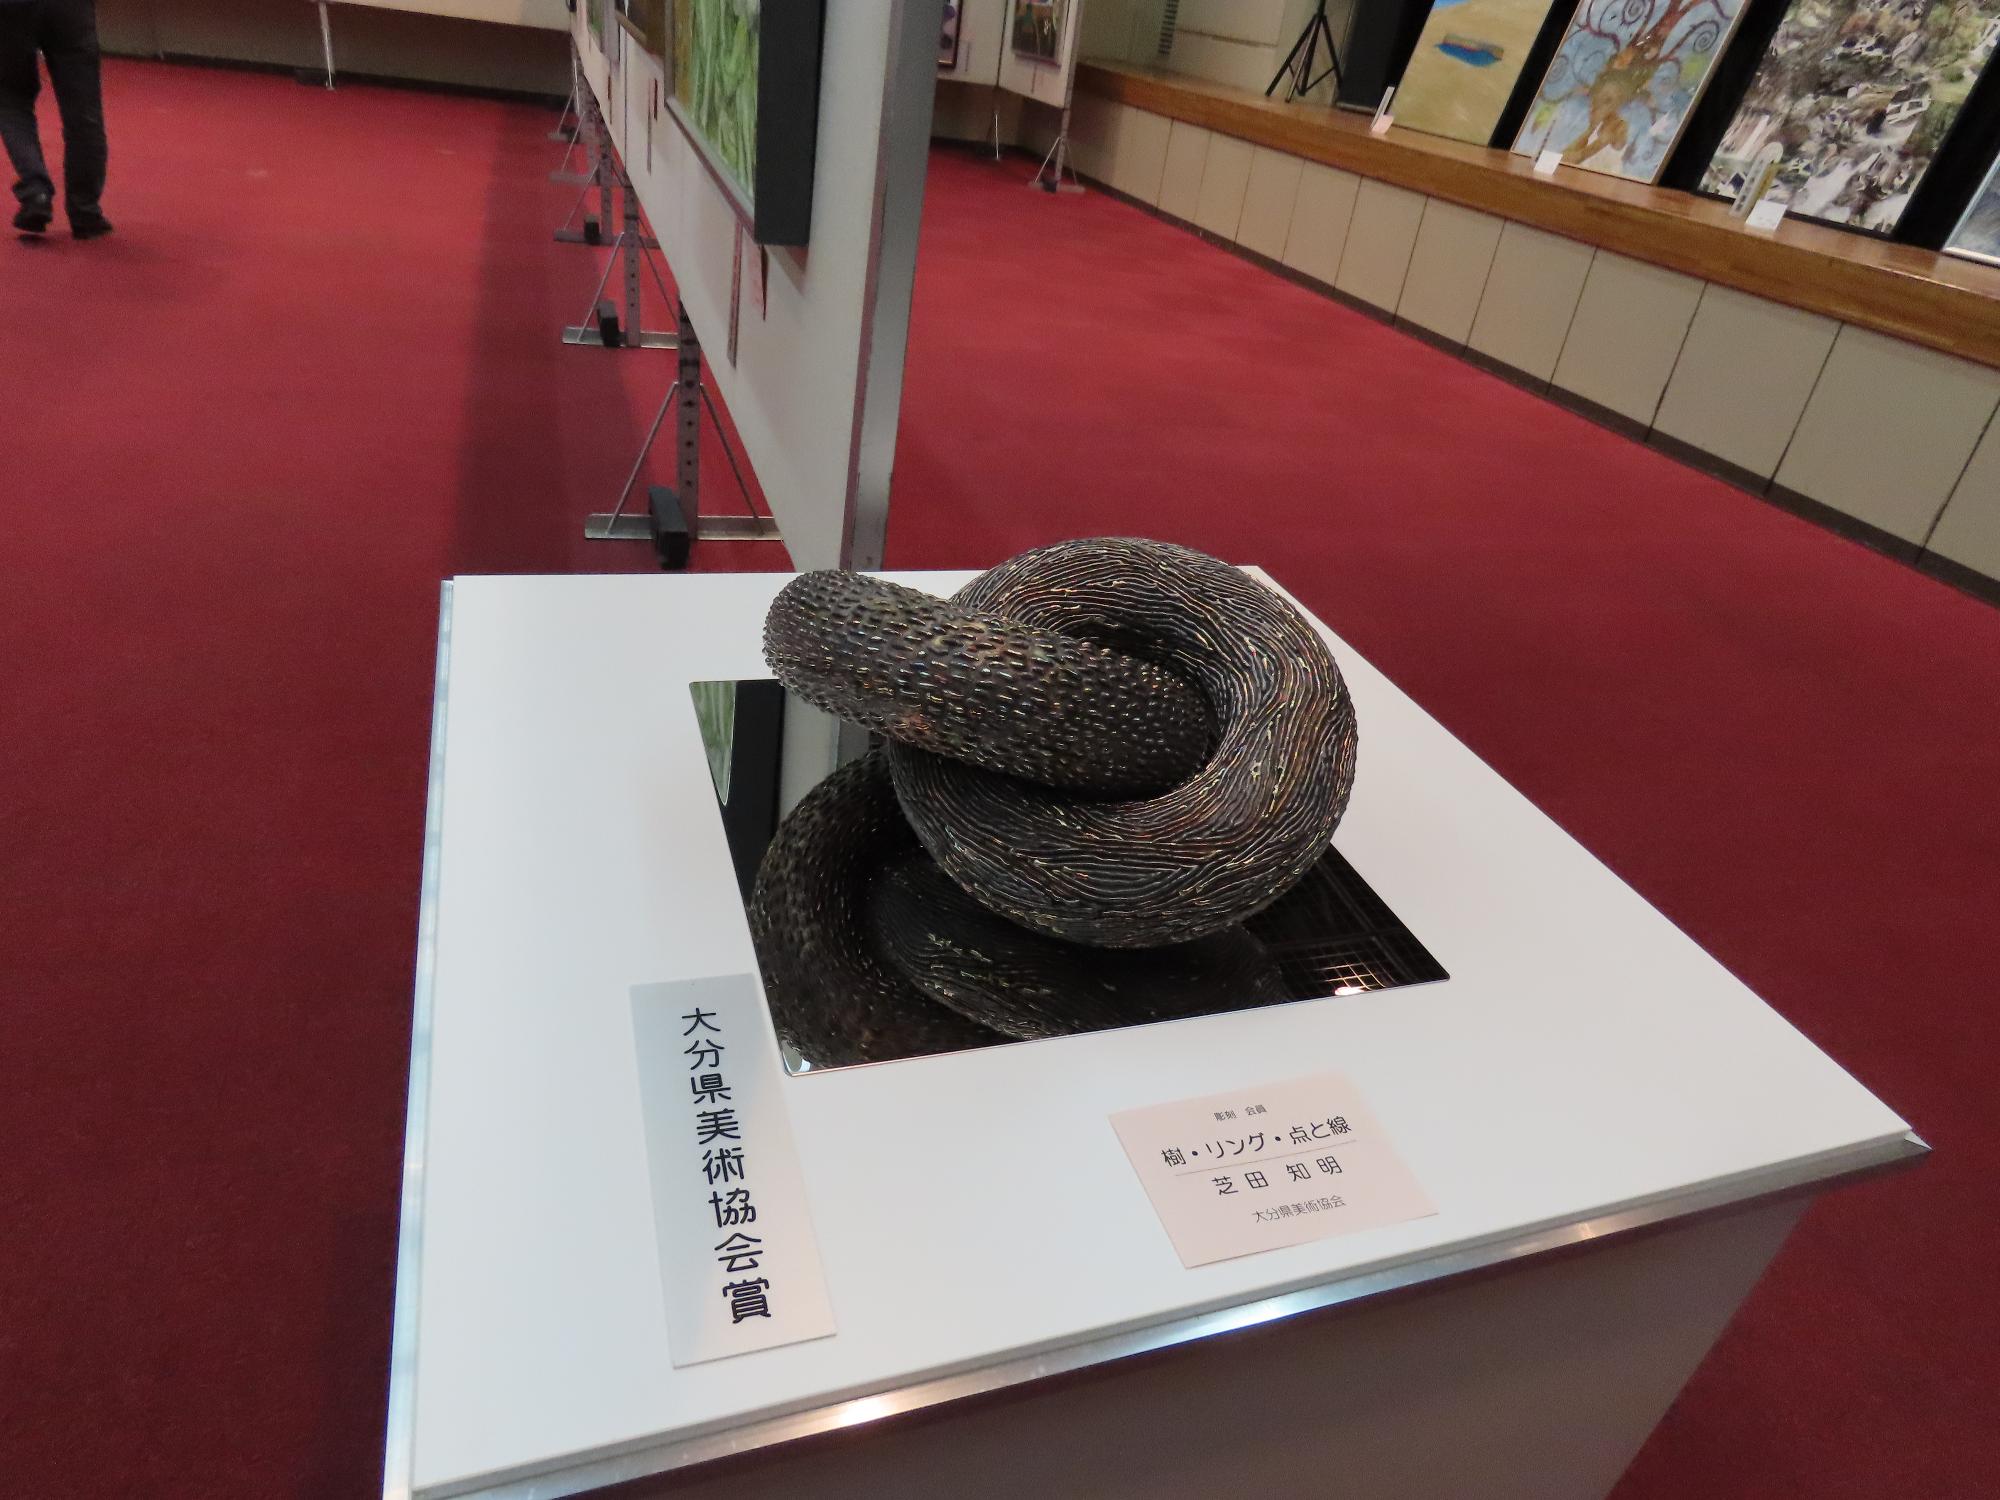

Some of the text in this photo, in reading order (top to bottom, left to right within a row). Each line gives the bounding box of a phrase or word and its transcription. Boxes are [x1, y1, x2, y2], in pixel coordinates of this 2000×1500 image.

[682, 1007, 771, 1324] 大分県美術協会賞
[1161, 1115, 1352, 1167] 樹・リング・点と線
[1252, 1196, 1346, 1223] 大分県美術協会
